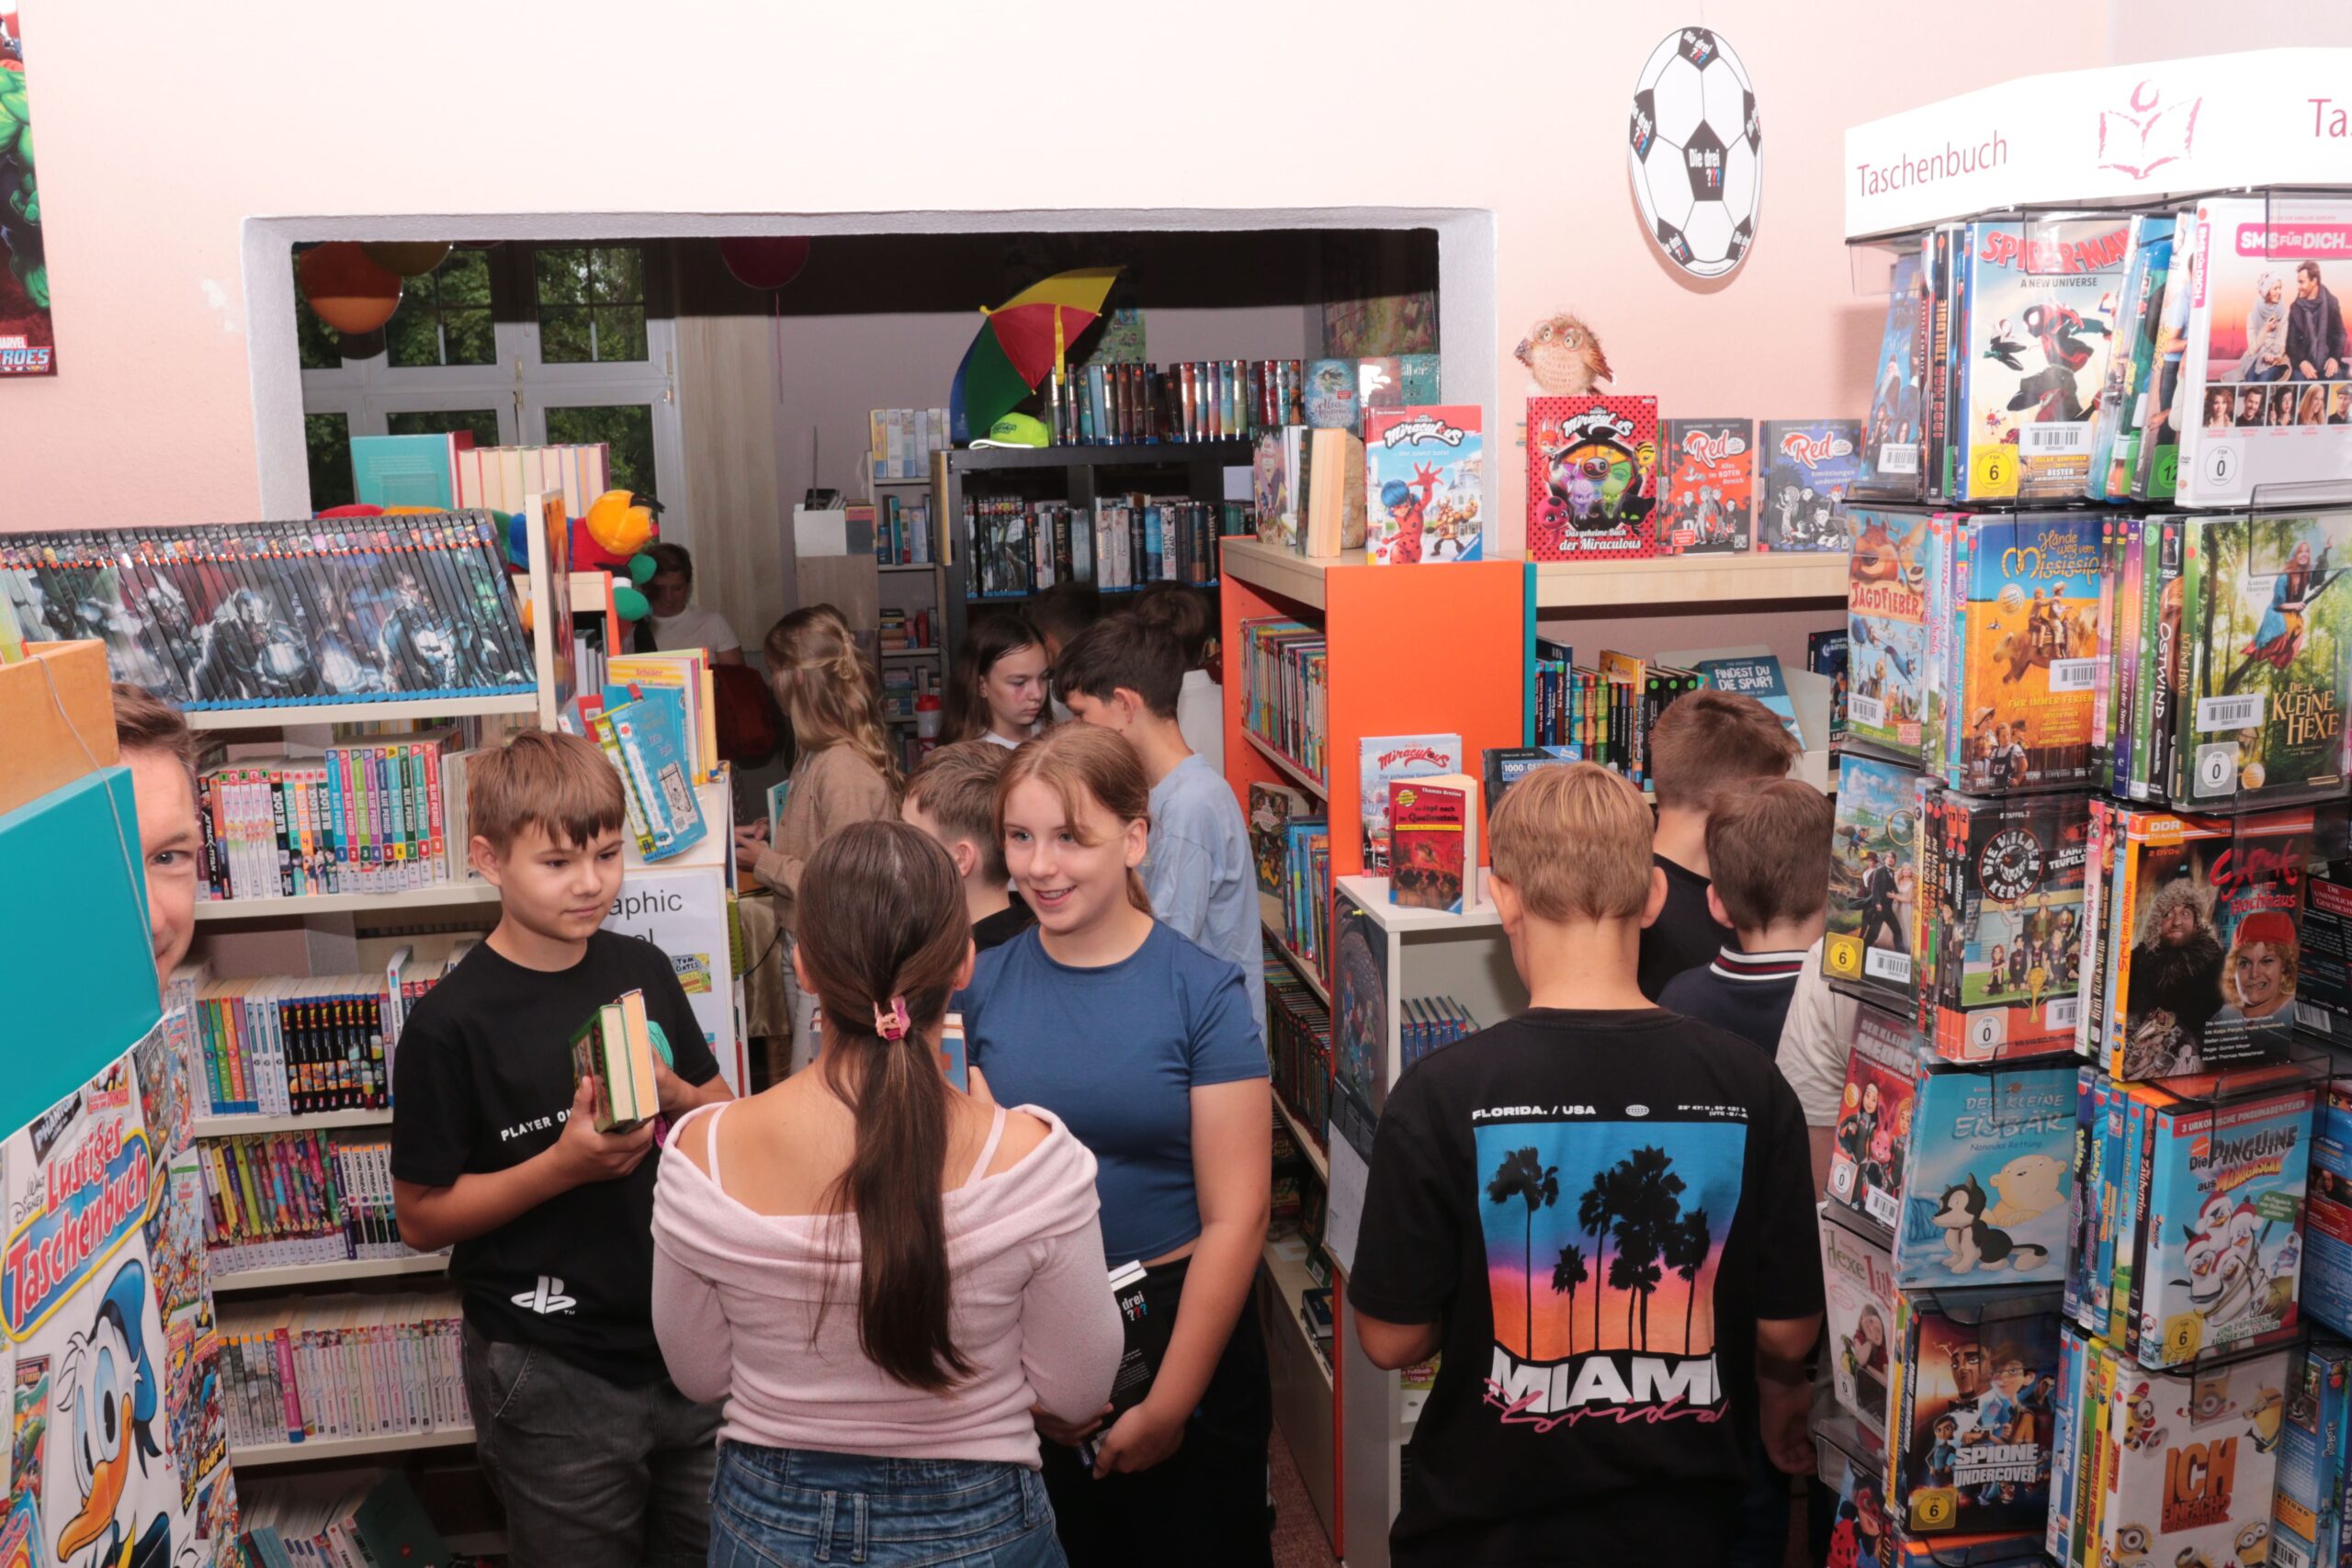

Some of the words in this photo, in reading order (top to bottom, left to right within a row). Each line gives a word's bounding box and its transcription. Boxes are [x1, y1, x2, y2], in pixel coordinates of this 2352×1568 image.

[1689, 149, 1703, 168] Die
[1704, 149, 1720, 168] drei
[1858, 130, 2007, 197] Taschenbuch
[2241, 231, 2279, 249] SMS
[2279, 231, 2302, 248] FÜR
[2021, 278, 2028, 288] A
[2029, 278, 2050, 288] NEW
[2052, 277, 2098, 288] UNIVERSE
[1935, 299, 1947, 361] TRILOGIE
[1384, 420, 1464, 449] Miraculous
[1683, 429, 1730, 468] Red
[1781, 431, 1834, 469] Red
[1989, 465, 1999, 480] 6
[2216, 460, 2226, 476] 0
[1559, 540, 1579, 551] der
[1580, 538, 1642, 550] Miraculous
[2038, 529, 2078, 551] Hände
[2057, 544, 2076, 558] weg
[1851, 581, 1919, 615] JAGDFIEBER
[2142, 573, 2150, 633] REITERHOF
[1713, 666, 1754, 679] FINDEST
[1756, 665, 1771, 676] DU
[2155, 622, 2172, 719] OSTWIND
[1717, 679, 1736, 690] DIE
[1738, 676, 1774, 689] SPUR?
[2289, 682, 2302, 694] DIE
[2008, 695, 2028, 708] FÜR
[2030, 695, 2063, 707] IMMER
[2272, 689, 2335, 721] KLEINE
[2119, 705, 2128, 735] Sterne
[2287, 713, 2339, 745] HEXE
[1378, 747, 1451, 770] Miraculous
[1503, 763, 1524, 773] 1000
[2211, 762, 2222, 780] 0
[334, 793, 342, 810] BLUE
[345, 793, 354, 810] BLUE
[368, 792, 377, 809] BLUE
[403, 789, 413, 806] BLUE
[416, 786, 424, 805] BLUE
[430, 784, 439, 804] BLUE
[334, 812, 344, 835] PERIOD
[345, 812, 355, 835] PERIOD
[369, 811, 378, 834] PERIOD
[382, 810, 390, 833] PERIOD
[418, 807, 426, 829] PERIOD
[432, 807, 440, 827] PERIOD
[1948, 812, 1956, 821] 11
[1959, 813, 1967, 823] 12
[2150, 821, 2181, 832] DDR
[351, 851, 356, 859] 2
[2156, 848, 2180, 856] DVDs
[2209, 840, 2301, 901] Spuk
[2122, 881, 2132, 922] Hochhaus
[2230, 893, 2297, 916] Hochhaus
[1838, 951, 1847, 965] 6
[2093, 940, 2105, 998] BLOCKSBERG
[2091, 998, 2102, 1021] BIBI
[1983, 1026, 1991, 1043] 0
[1472, 1105, 1549, 1121] FLORIDA.
[1552, 1105, 1558, 1115] /
[1562, 1105, 1596, 1115] USA
[2181, 1124, 2187, 1133] 3
[2238, 1100, 2306, 1122] PINGUINABENTEUER
[501, 1116, 552, 1142] PLAYER
[2189, 1156, 2208, 1171] Die
[2208, 1125, 2298, 1169] PINGUINE
[48, 1117, 123, 1217] Lustiges
[2198, 1179, 2217, 1192] aus
[2216, 1157, 2283, 1192] MADAGASCAR
[6, 1145, 148, 1332] Taschenbuch
[1824, 1229, 1866, 1280] Hexe
[1121, 1291, 1145, 1312] drei
[2179, 1331, 2188, 1346] 6
[1487, 1345, 1723, 1414] MIAMI
[1842, 1381, 1848, 1393] 0
[198, 1438, 225, 1474] GOOFY
[1954, 1443, 2039, 1465] SPIONE
[1953, 1466, 2037, 1486] UNDERCOVER
[2165, 1436, 2238, 1501] ICH
[1929, 1503, 1939, 1517] 6
[2162, 1495, 2219, 1522] EINFACH
[2219, 1494, 2233, 1520] 2
